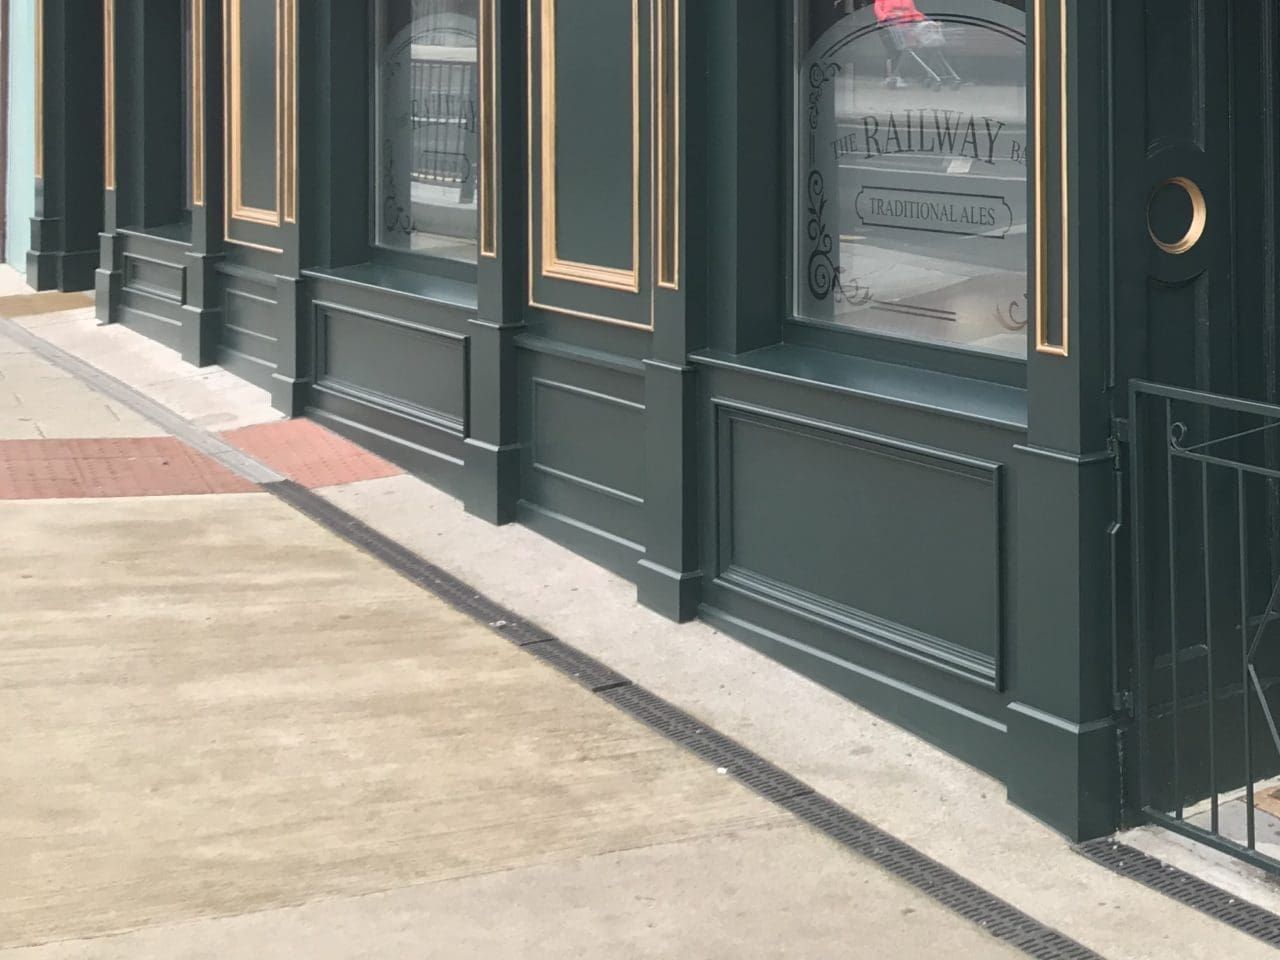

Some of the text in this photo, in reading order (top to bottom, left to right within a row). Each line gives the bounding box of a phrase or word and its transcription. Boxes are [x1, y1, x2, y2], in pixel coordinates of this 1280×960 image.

[831, 133, 858, 161] THE
[861, 108, 1006, 165] RAILWAY
[869, 197, 996, 226] TRADITIONAL ALES
